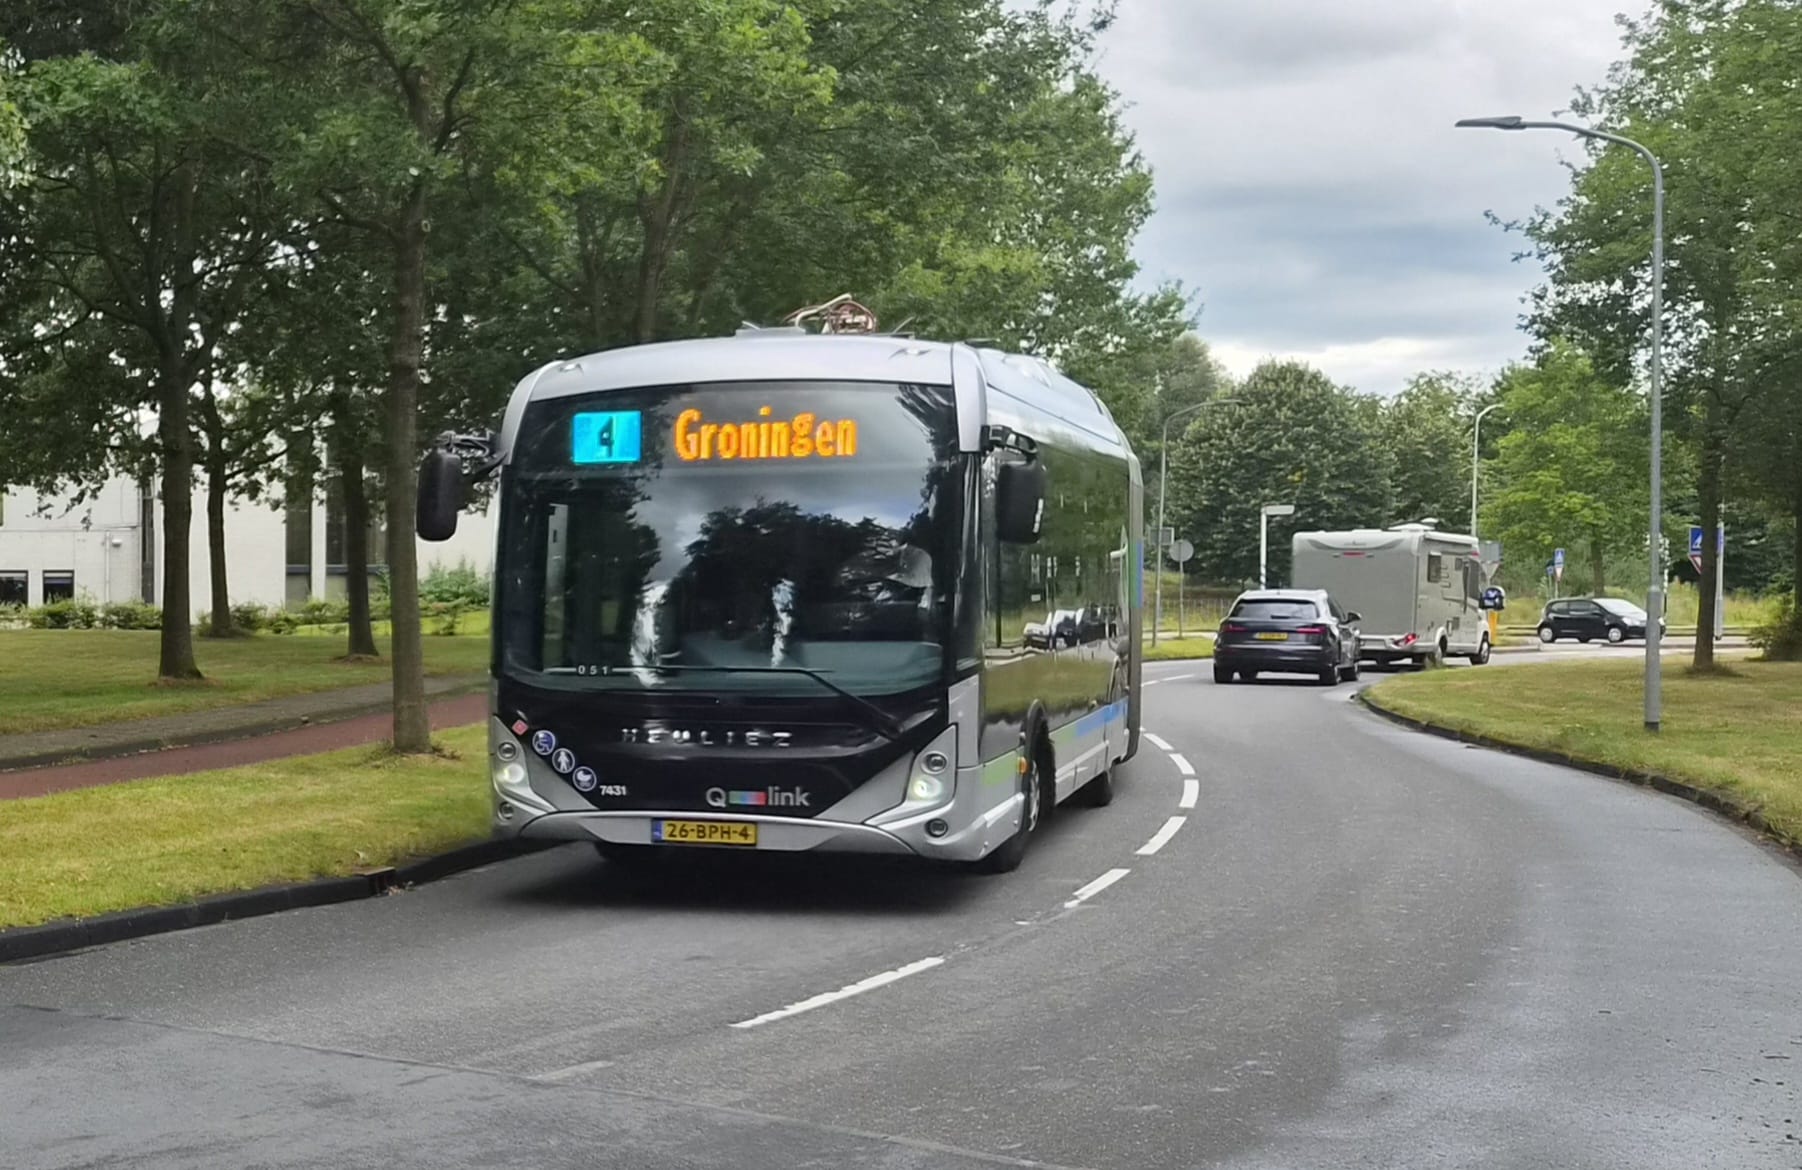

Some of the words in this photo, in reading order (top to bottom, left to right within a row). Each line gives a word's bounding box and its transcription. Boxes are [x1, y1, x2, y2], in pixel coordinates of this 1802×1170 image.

[598, 416, 616, 458] 4
[675, 406, 858, 461] Groningen
[599, 784, 628, 797] 7431
[666, 822, 751, 842] 26-BPH-4
